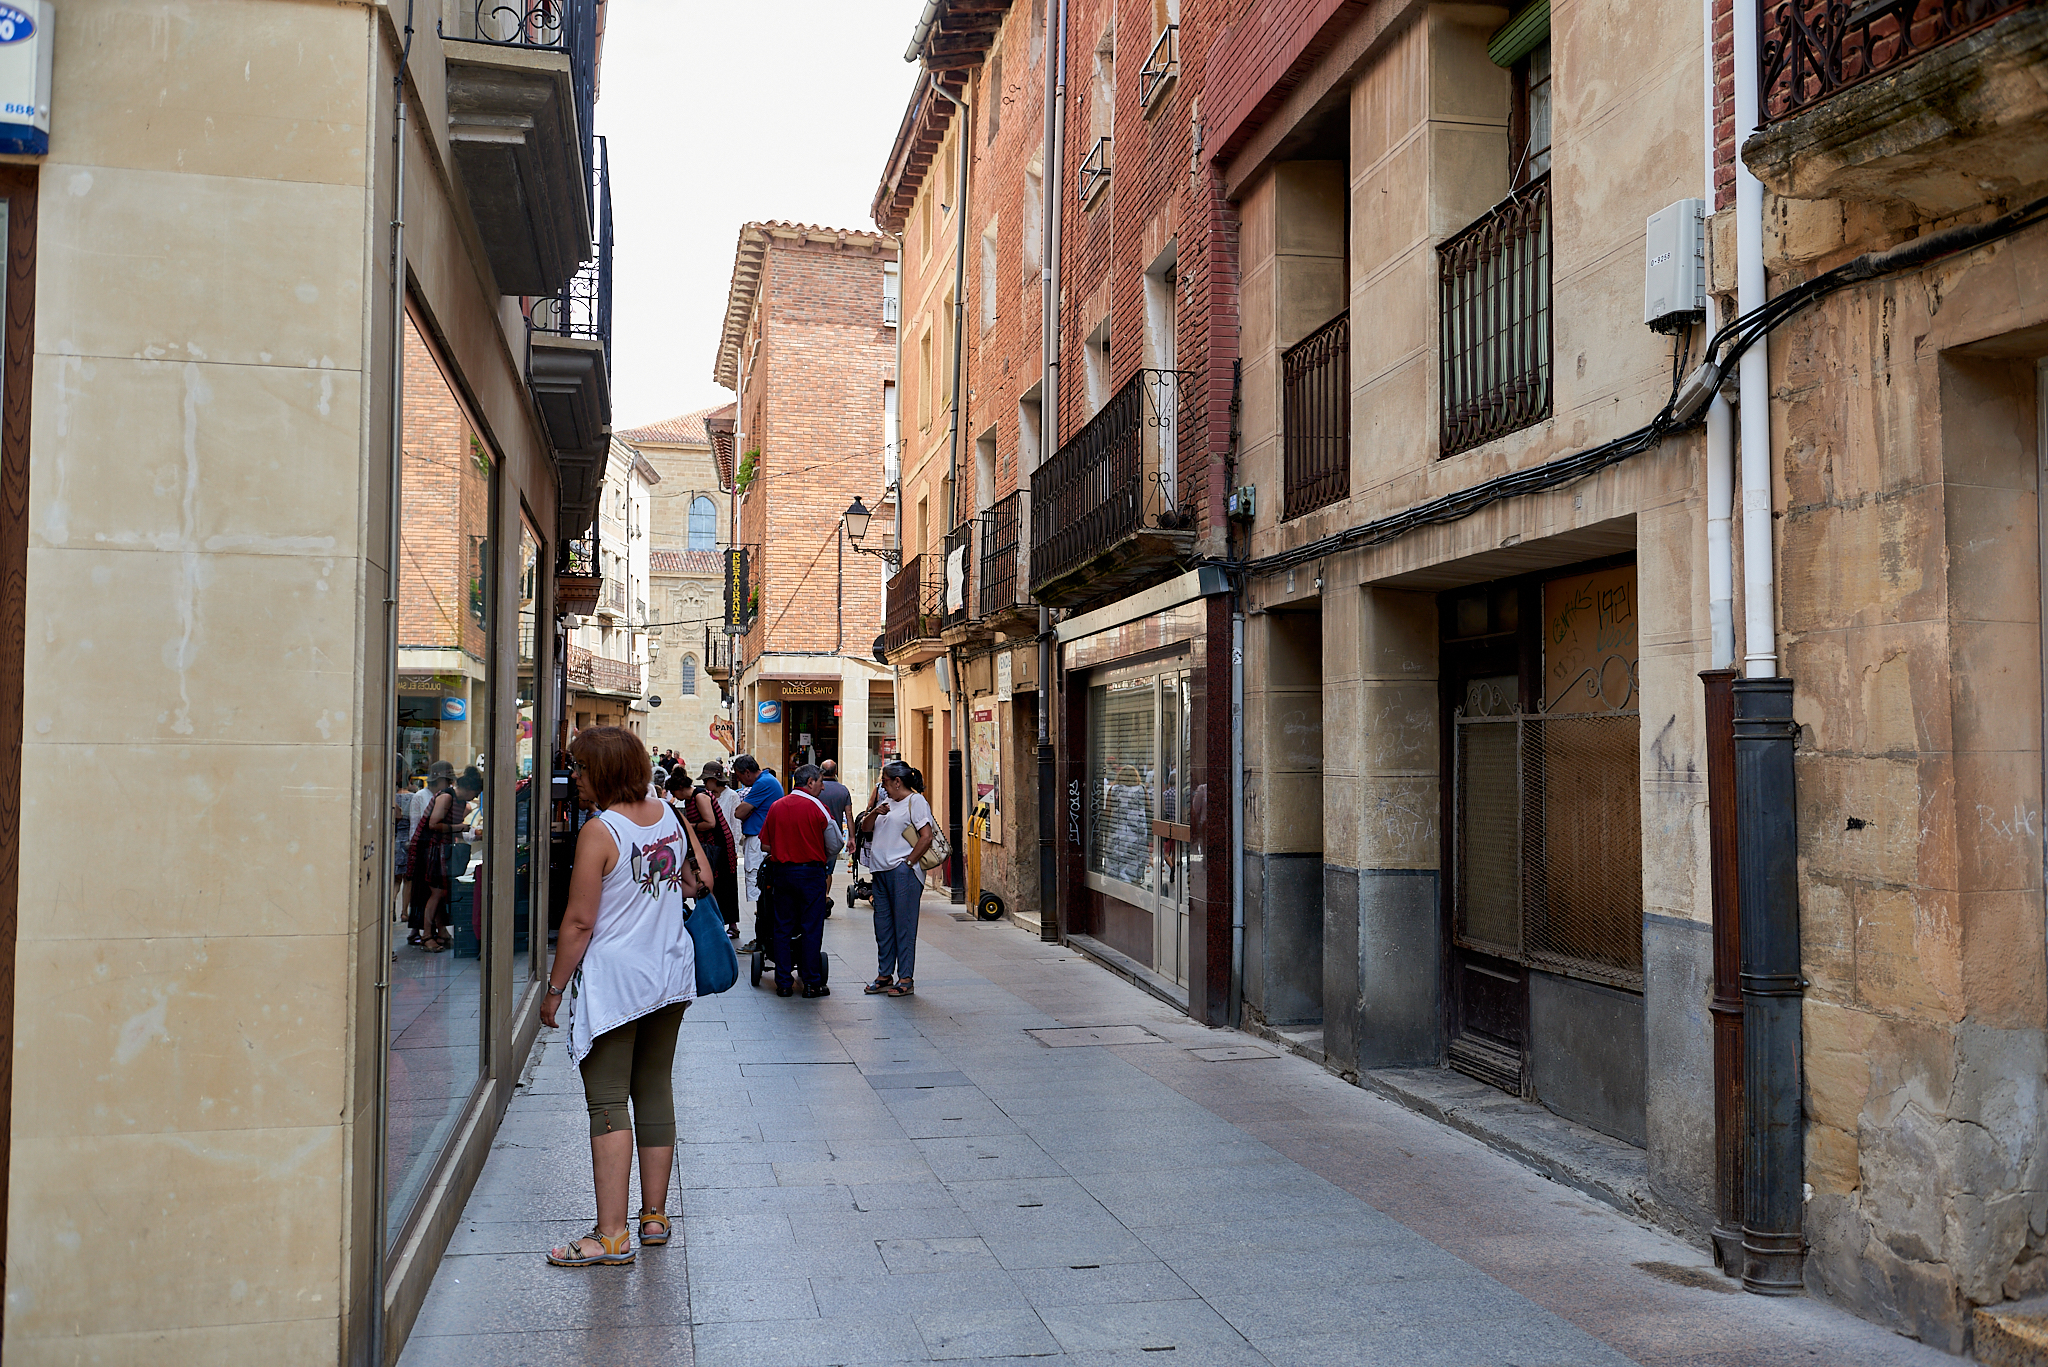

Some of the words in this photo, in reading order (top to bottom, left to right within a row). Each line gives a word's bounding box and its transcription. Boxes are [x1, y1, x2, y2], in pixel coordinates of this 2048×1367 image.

[732, 552, 741, 625] RESTAURANTE
[782, 686, 804, 695] DULCES
[805, 686, 812, 695] EL
[813, 686, 833, 695] SANTO
